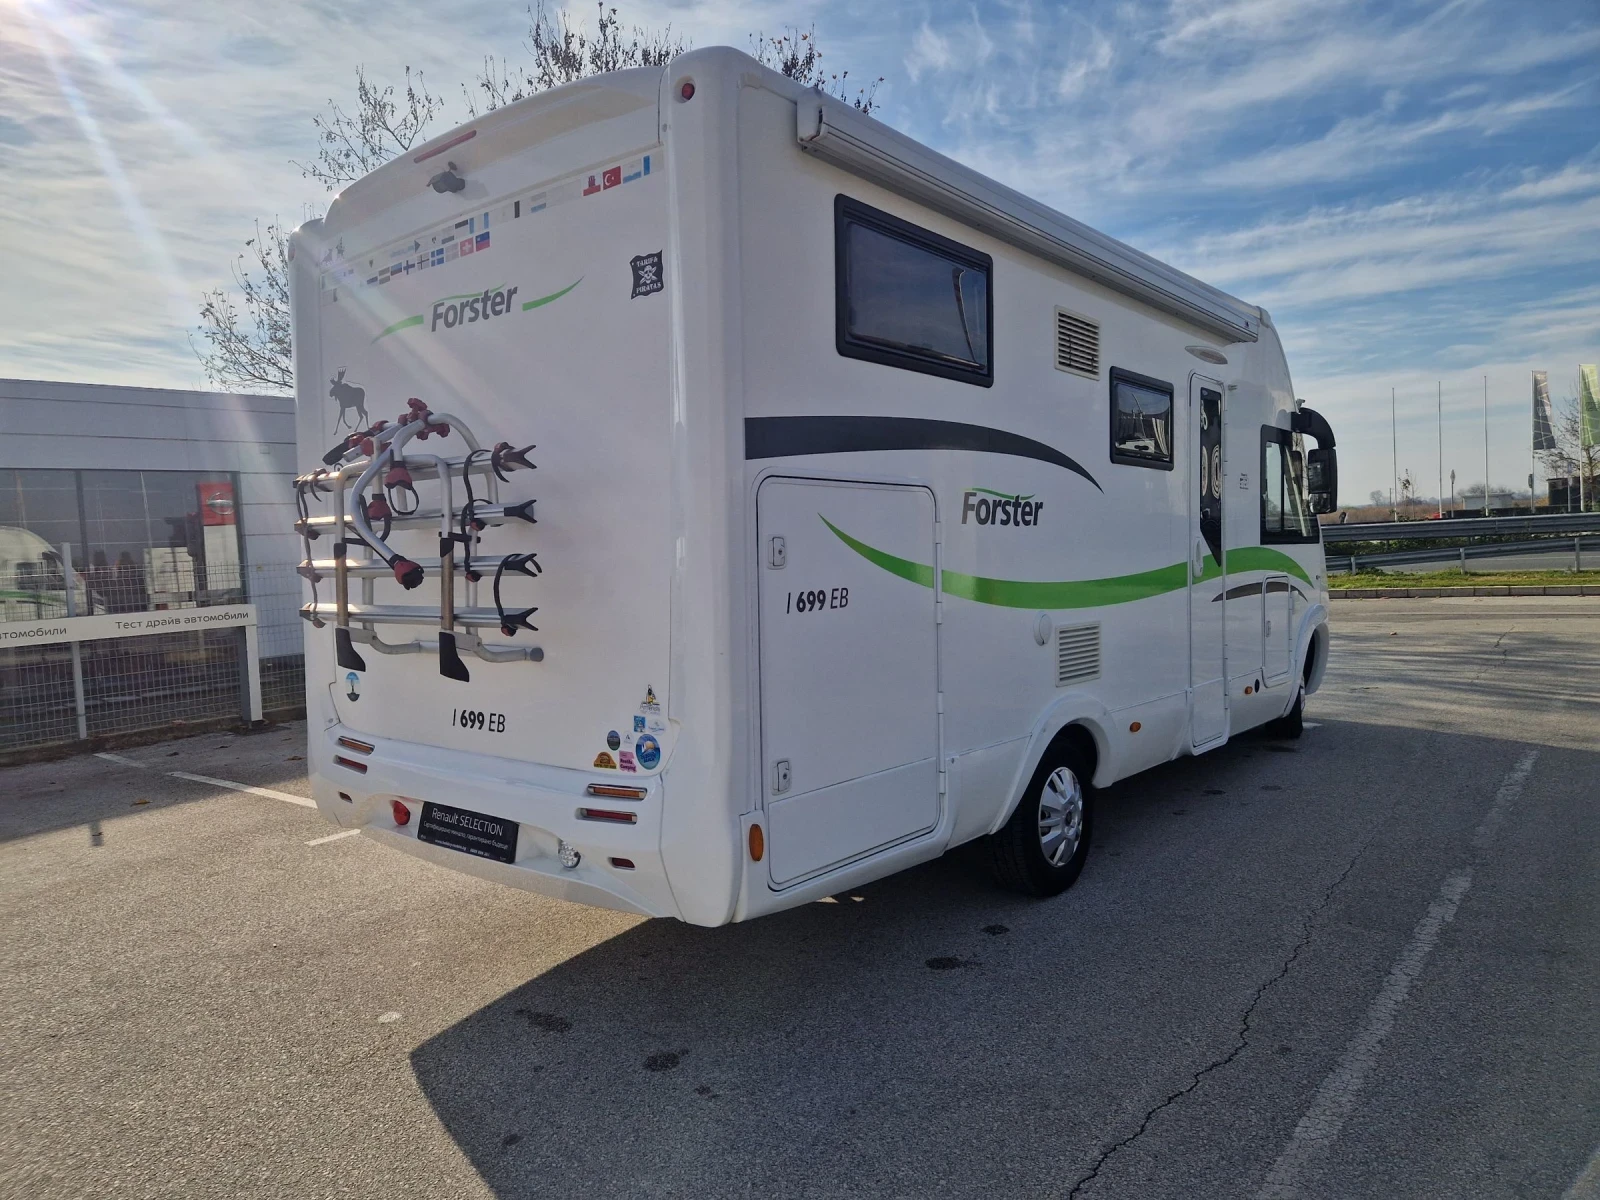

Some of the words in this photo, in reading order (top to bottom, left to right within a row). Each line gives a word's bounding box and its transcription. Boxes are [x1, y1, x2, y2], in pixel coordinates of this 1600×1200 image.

[636, 282, 662, 293] PIRATAS
[431, 286, 518, 332] Forster
[961, 493, 1044, 527] Forster
[796, 590, 826, 613] 699
[830, 587, 849, 609] EB
[0, 627, 67, 639] томобили
[115, 620, 143, 630] Тест
[145, 615, 181, 628] драйв
[184, 612, 249, 624] автомобили
[460, 709, 485, 730] 699
[488, 712, 506, 733] EB
[431, 808, 458, 824] Renault
[459, 815, 504, 837] SELECTION
